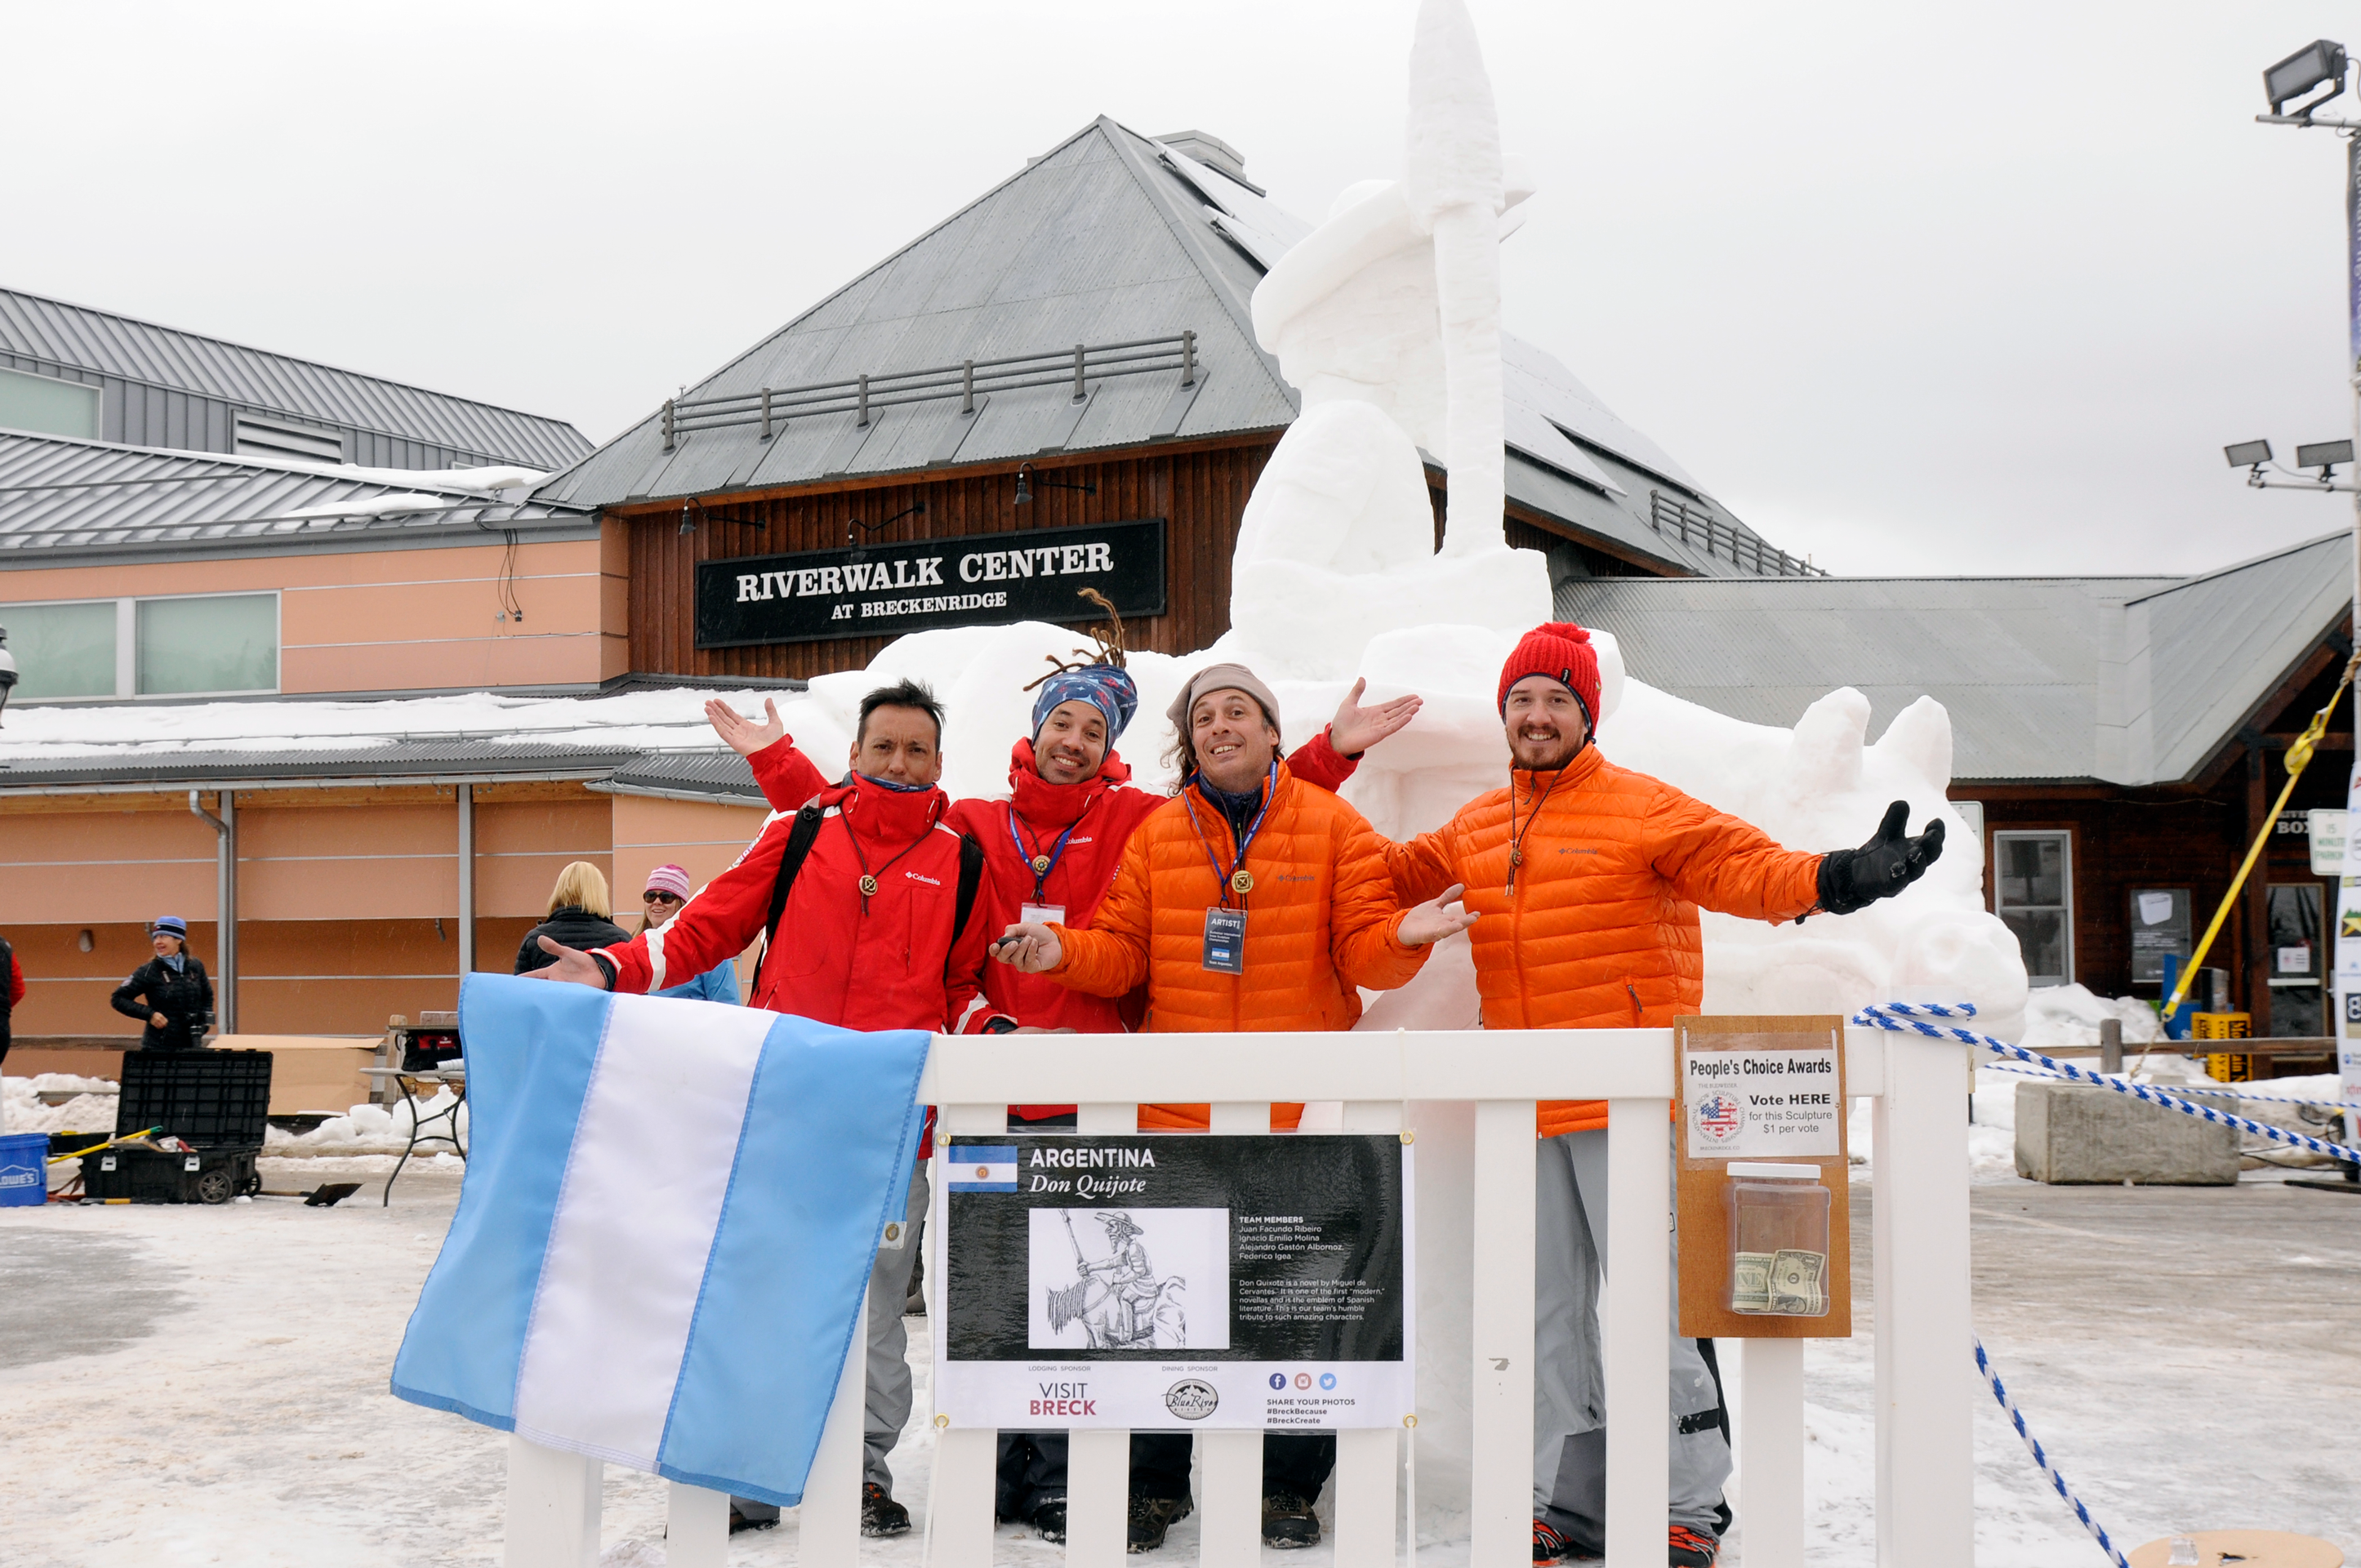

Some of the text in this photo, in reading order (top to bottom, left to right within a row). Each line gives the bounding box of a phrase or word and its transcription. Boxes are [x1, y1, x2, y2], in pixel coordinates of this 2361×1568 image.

[736, 542, 1114, 603] RIVERWALK CENTER
[831, 592, 1007, 620] AT BRECKENRIDGE
[913, 873, 941, 885] Columbia
[1211, 918, 1237, 927] ARTIST
[1691, 1058, 1831, 1079] People's Choice Awards
[1749, 1094, 1831, 1105] Vote HERE
[1749, 1111, 1832, 1123] for this Sculpture
[1763, 1124, 1775, 1134] $1
[1779, 1125, 1795, 1134] per
[1030, 1148, 1156, 1168] ARGENTINA
[1, 1173, 34, 1184] OWE'S
[1029, 1174, 1146, 1200] Don Quijote
[1239, 1235, 1267, 1243] Ignacio
[1239, 1244, 1276, 1252] Alejandro
[1275, 1253, 1291, 1261] Igea
[1736, 1272, 1762, 1287] NE
[1039, 1383, 1088, 1398] VISIT
[1031, 1400, 1096, 1415] BRECK
